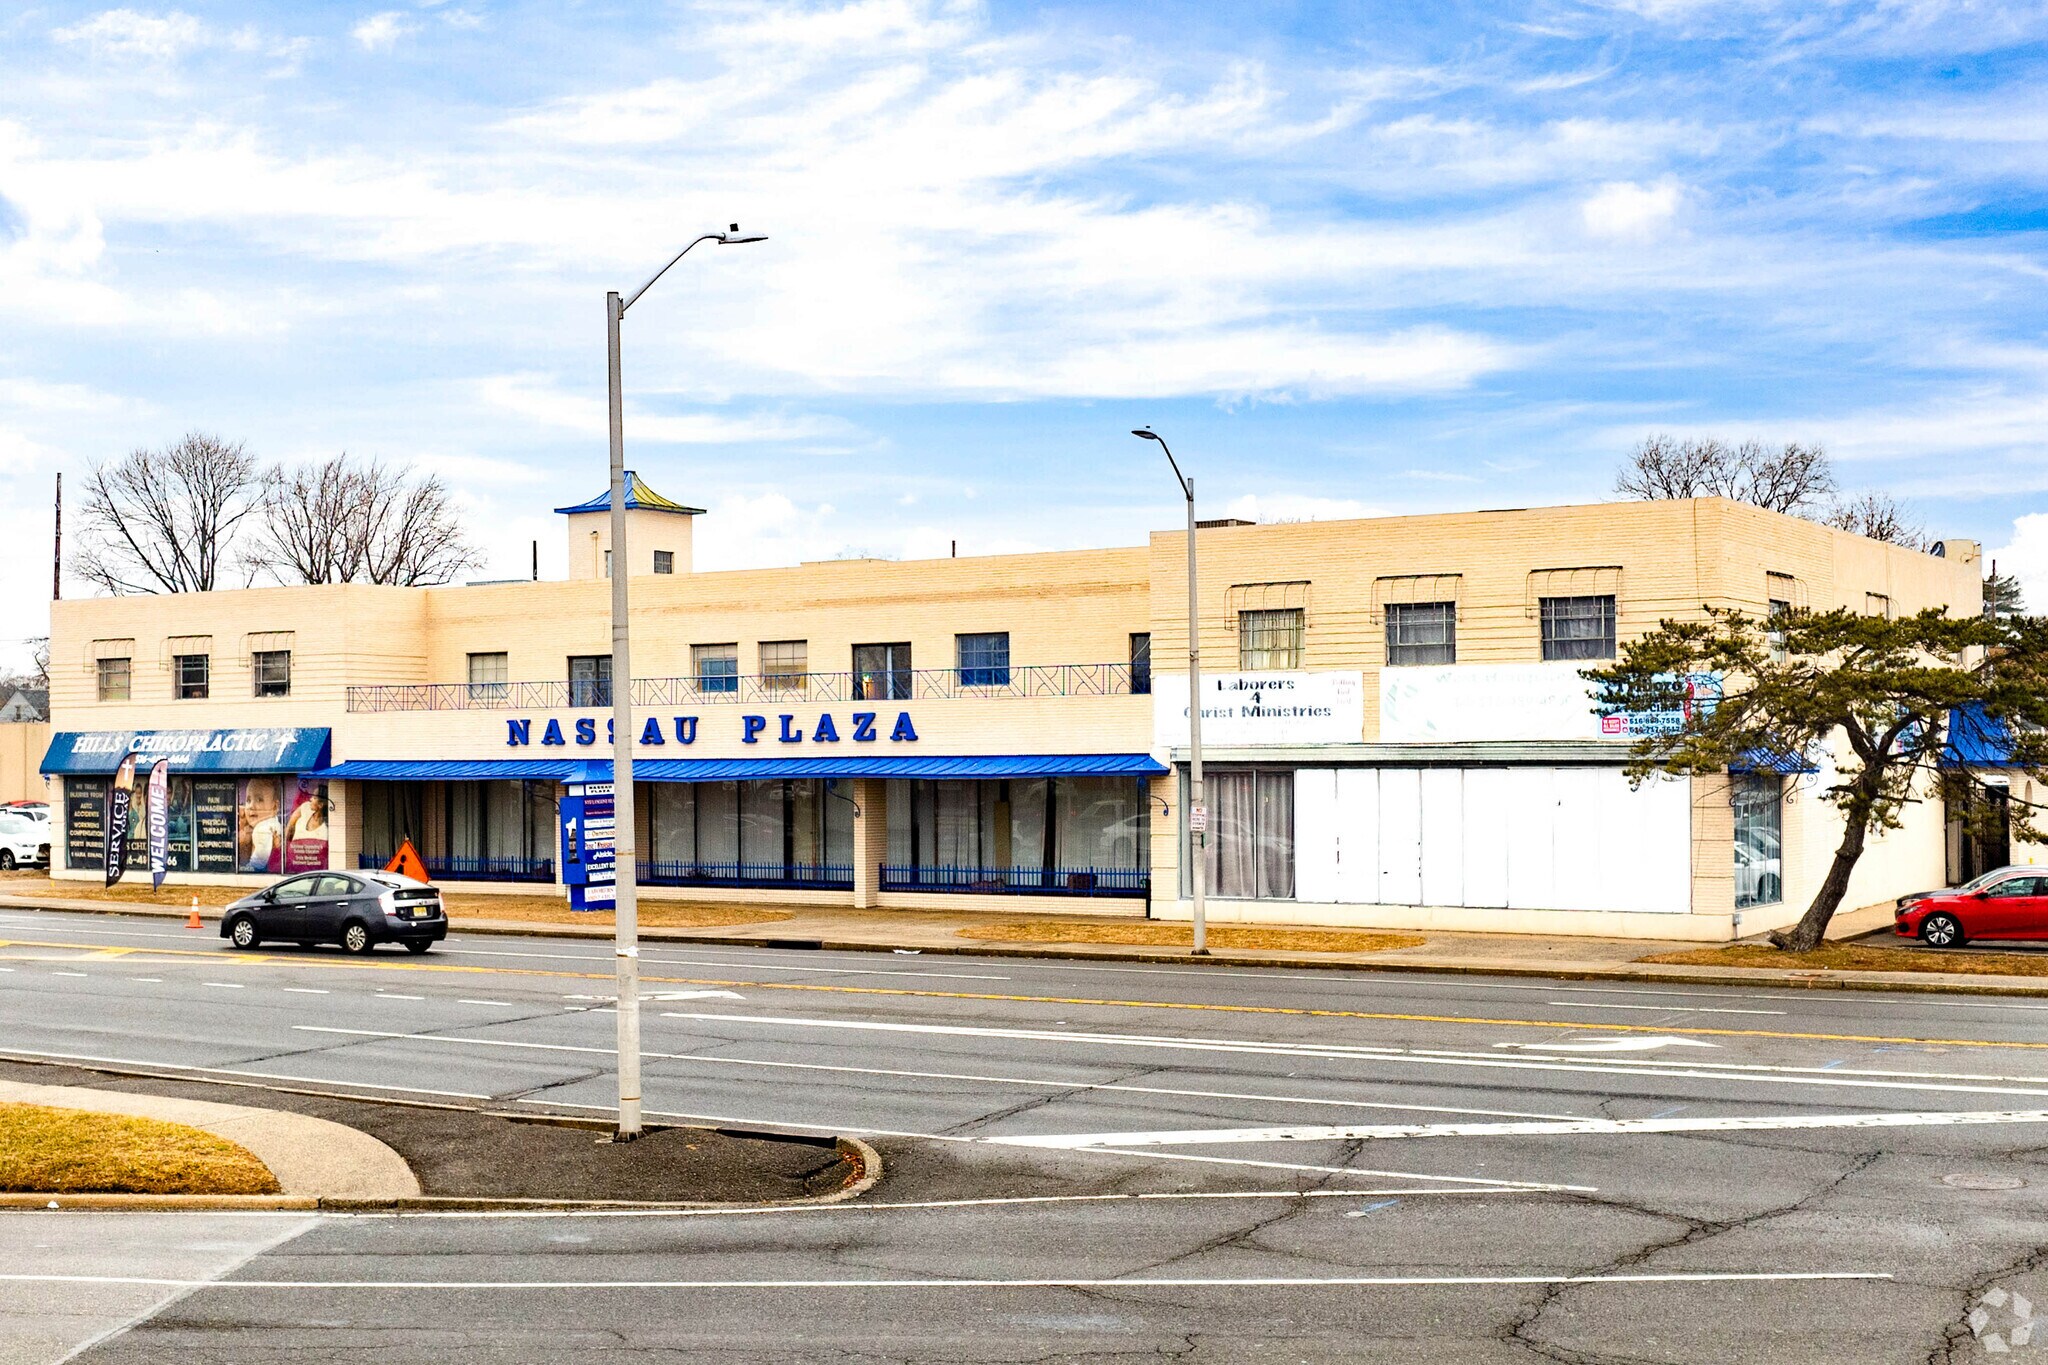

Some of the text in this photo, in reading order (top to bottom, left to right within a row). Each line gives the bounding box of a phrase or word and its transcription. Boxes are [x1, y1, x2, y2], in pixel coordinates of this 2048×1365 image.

[1217, 678, 1295, 691] Laborers
[1250, 691, 1262, 704] 4
[1241, 704, 1332, 718] Ministries
[742, 712, 919, 743] PLAZA
[71, 734, 269, 754] HILLS CHIROPRACTIC
[195, 782, 235, 791] CHIROPRACTIC
[196, 804, 233, 813] MANAGEMENT
[108, 792, 126, 878] SERVICE
[150, 784, 167, 874] WELCOME
[203, 826, 227, 835] THERAPY
